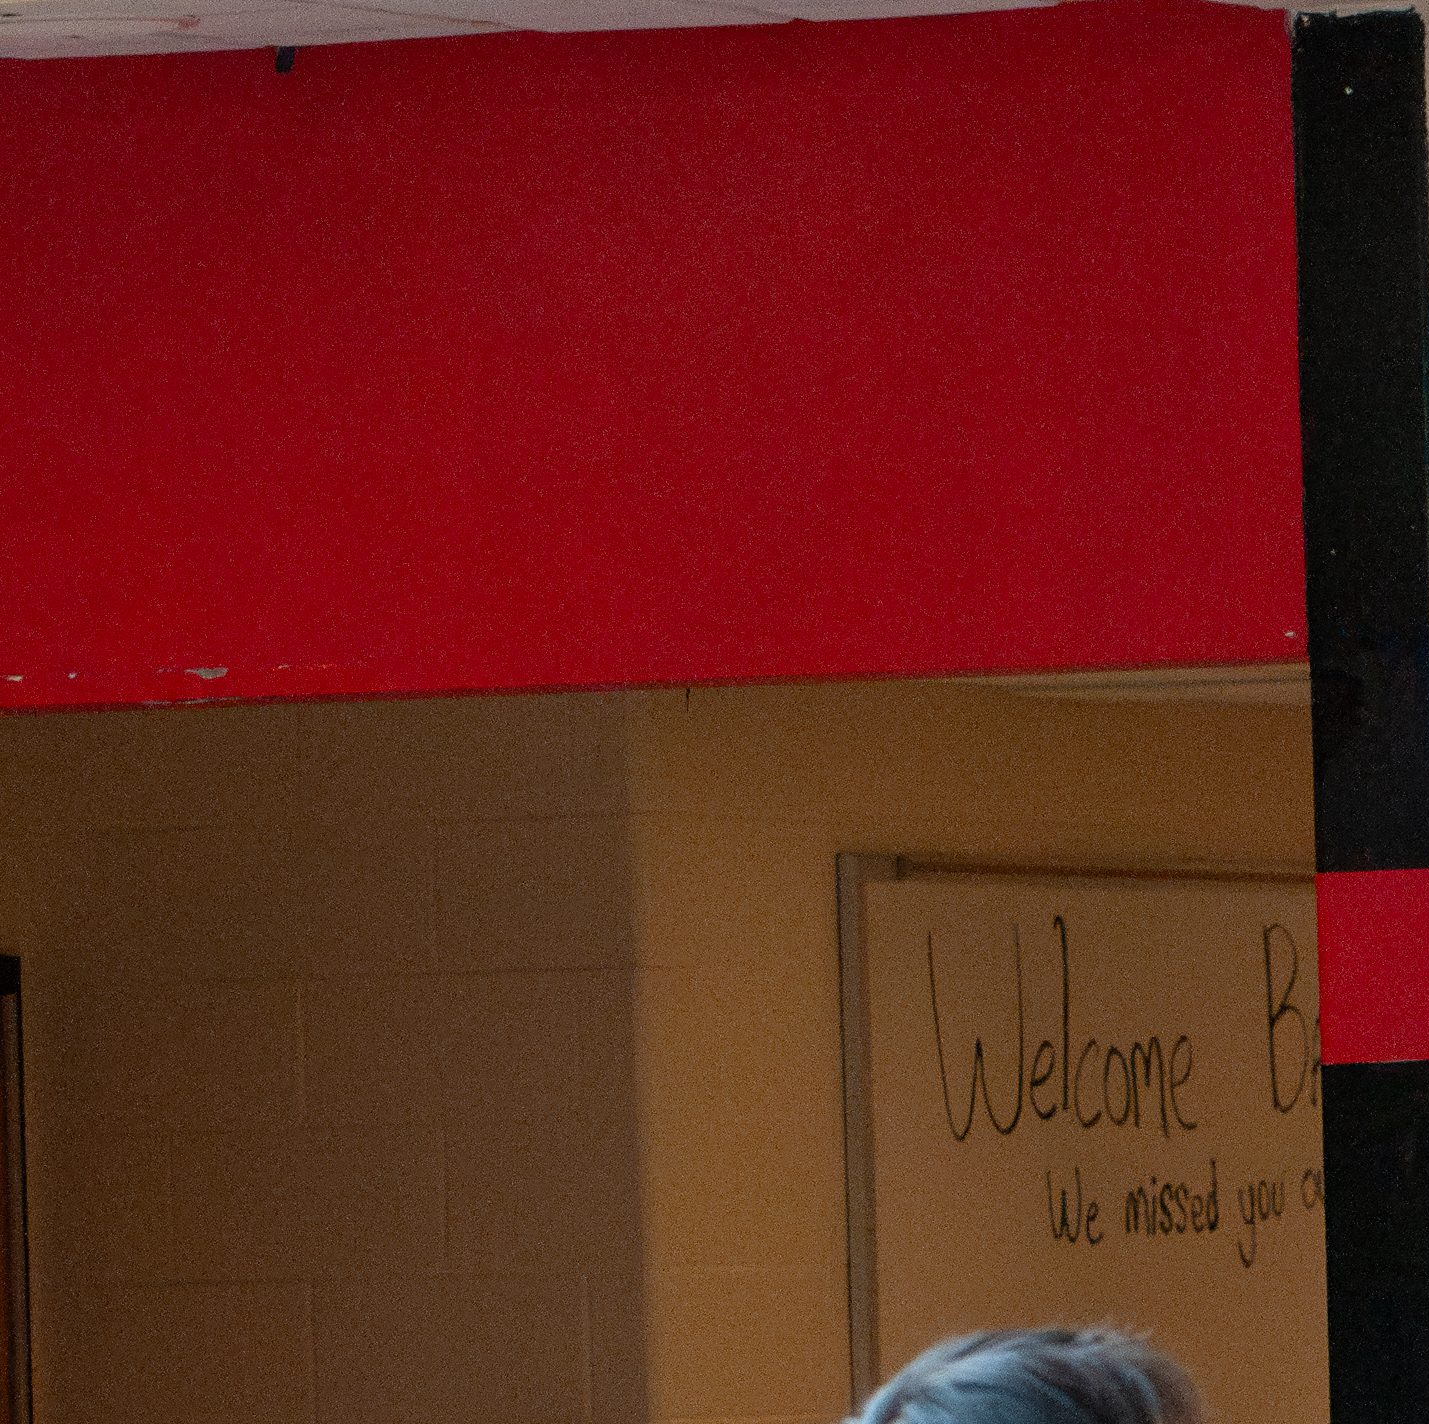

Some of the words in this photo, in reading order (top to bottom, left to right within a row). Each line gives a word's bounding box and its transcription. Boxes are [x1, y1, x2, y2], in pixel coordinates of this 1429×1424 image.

[927, 914, 1197, 1142] Welcome
[1046, 1166, 1104, 1245] We
[1124, 1159, 1219, 1237] missed
[1237, 1179, 1285, 1269] you
